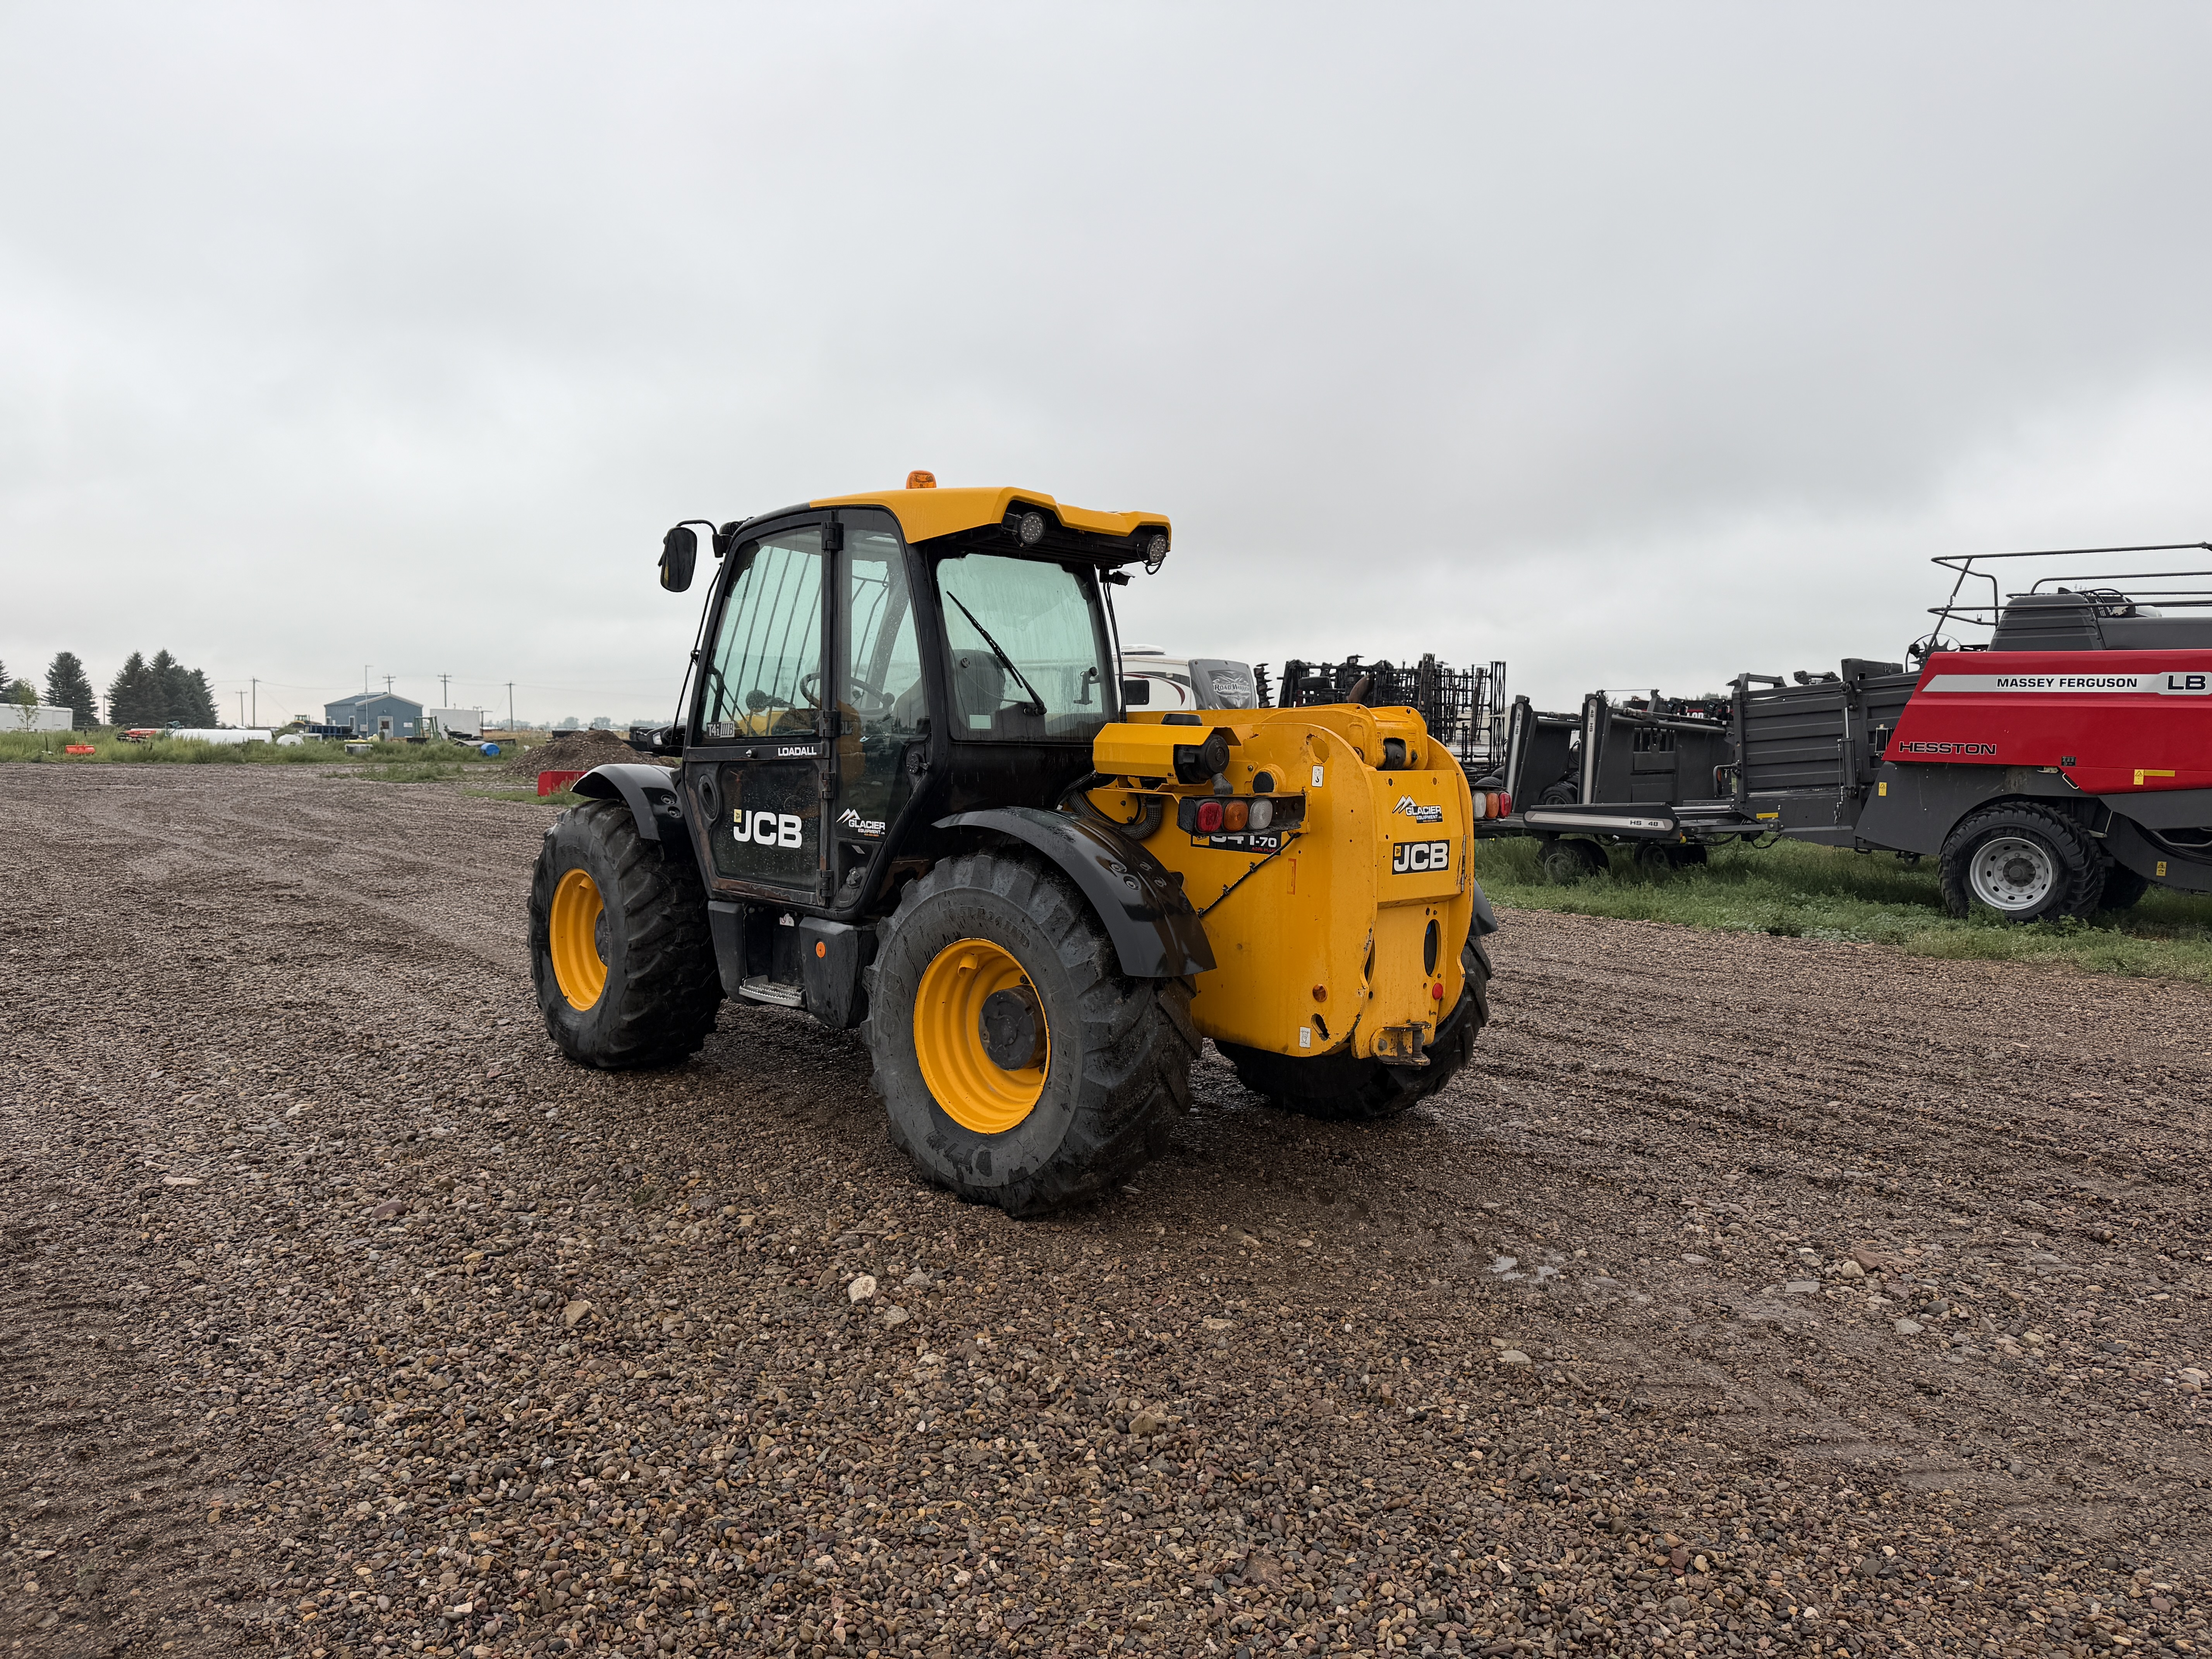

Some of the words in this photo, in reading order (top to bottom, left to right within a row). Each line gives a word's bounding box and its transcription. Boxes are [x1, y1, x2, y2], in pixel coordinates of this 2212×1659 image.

[1997, 678, 2054, 687] MASSEY
[2059, 678, 2137, 687] FERGUSON
[2168, 675, 2206, 690] LB
[708, 724, 720, 736] T4i
[778, 747, 816, 756] LOADALL
[1899, 742, 1996, 755] HESSTON
[1405, 805, 1441, 816] GLACIER
[733, 810, 802, 848] JCB
[848, 819, 885, 830] GLACIER
[1394, 843, 1448, 871] JCB
